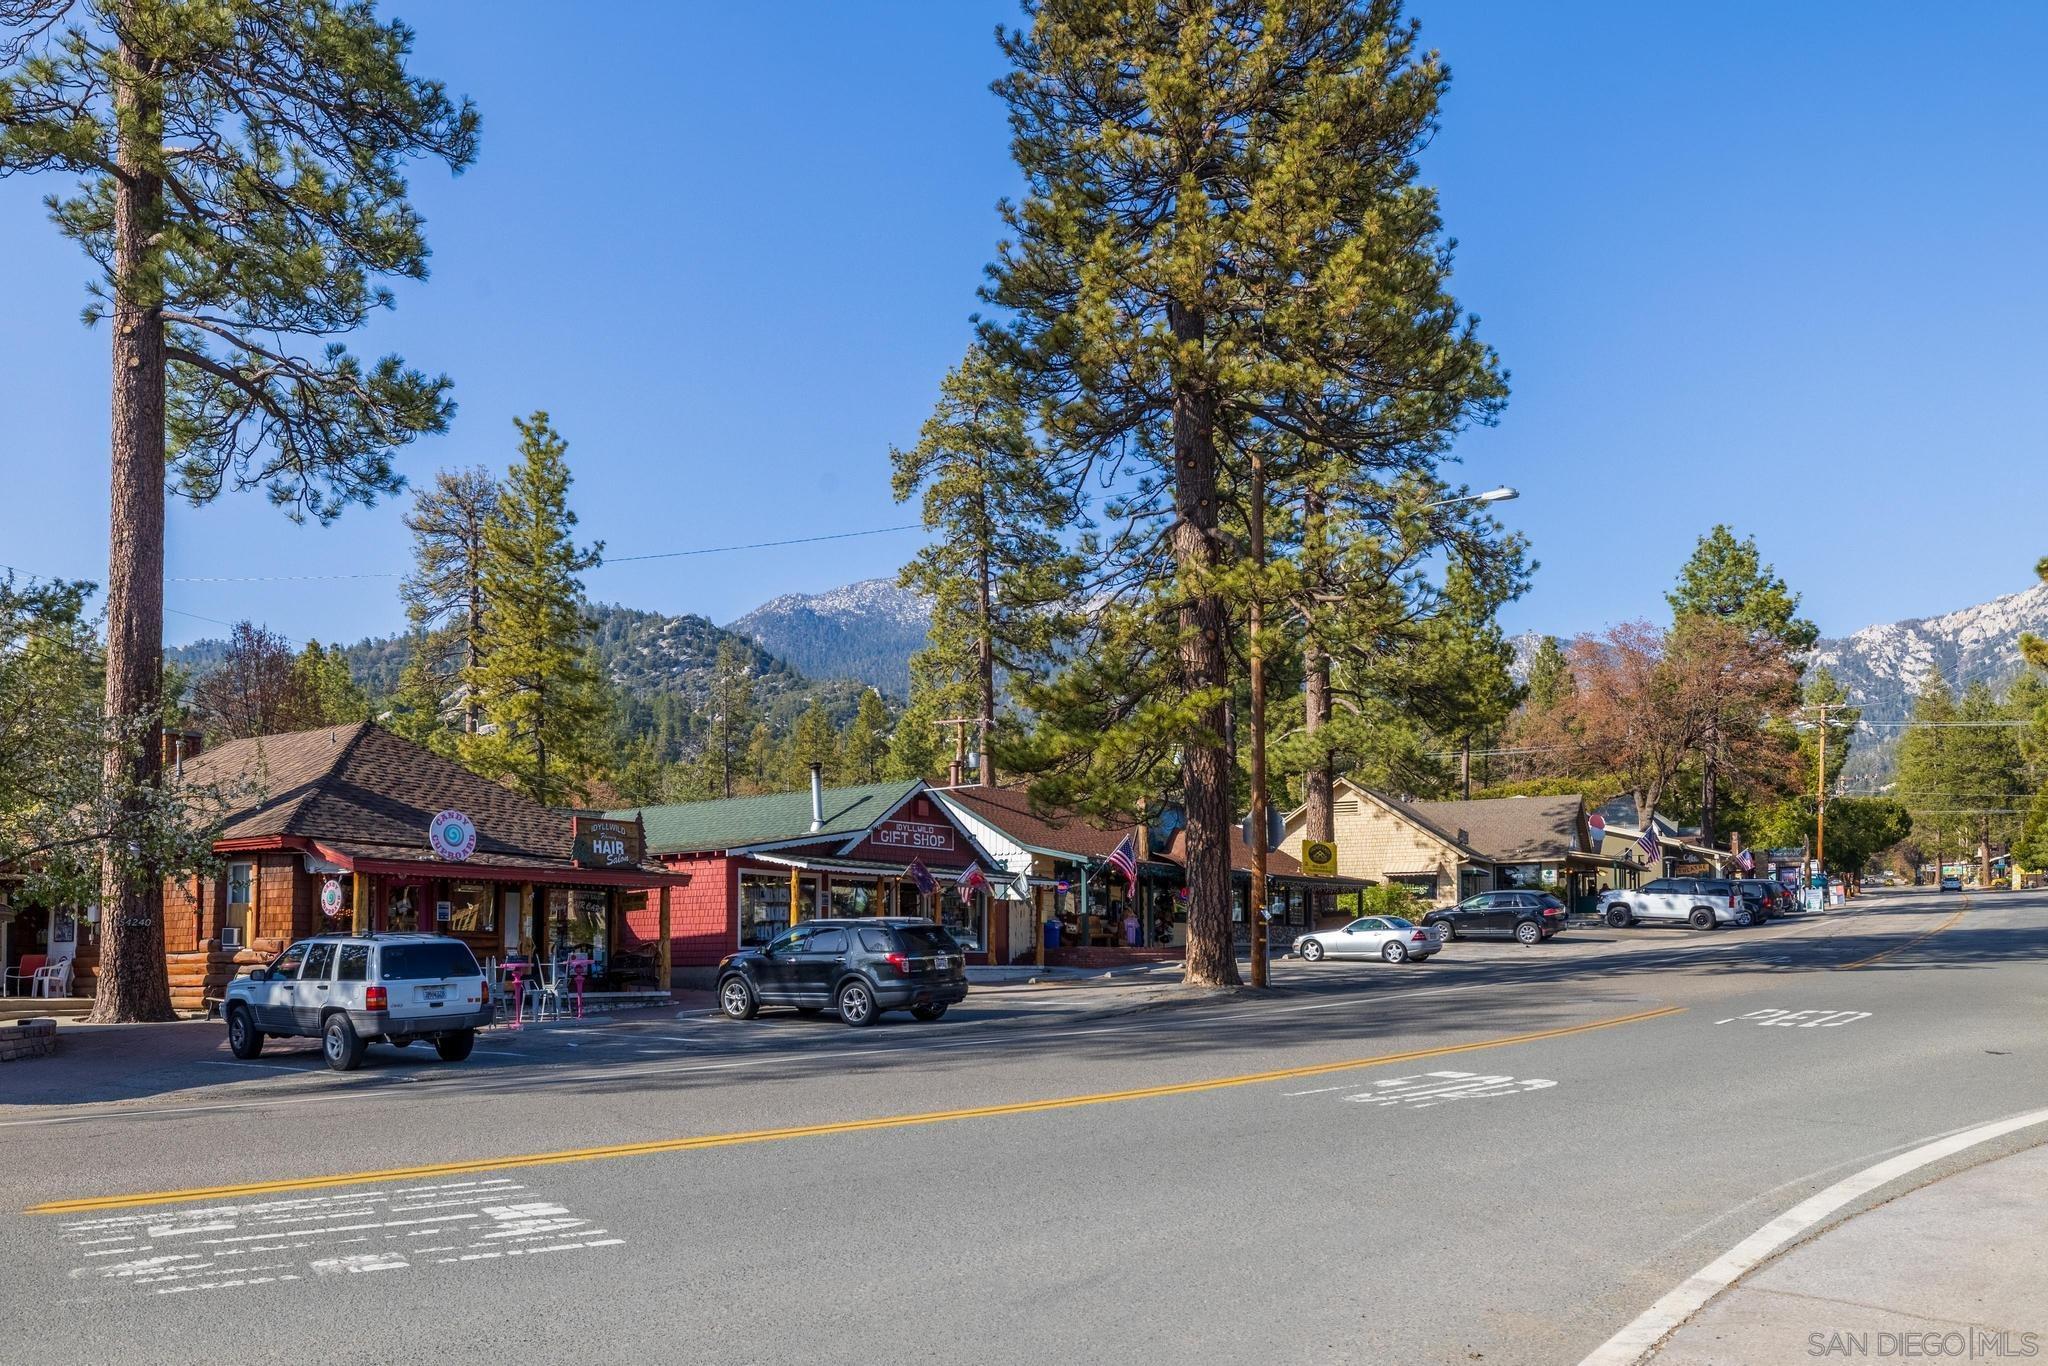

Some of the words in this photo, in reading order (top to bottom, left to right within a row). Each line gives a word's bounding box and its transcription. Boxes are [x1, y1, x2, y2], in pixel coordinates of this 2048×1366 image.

[436, 811, 469, 826] CANDY
[591, 823, 626, 835] IDYLLWILD
[896, 823, 935, 834] IDYLLWILD
[880, 830, 909, 844] GIFT
[913, 833, 946, 847] SHOP
[432, 834, 475, 860] CUPBOARD
[593, 840, 625, 855] HAIR
[606, 854, 629, 866] Salon
[119, 918, 152, 927] 54240
[1714, 1008, 1873, 1028] PED
